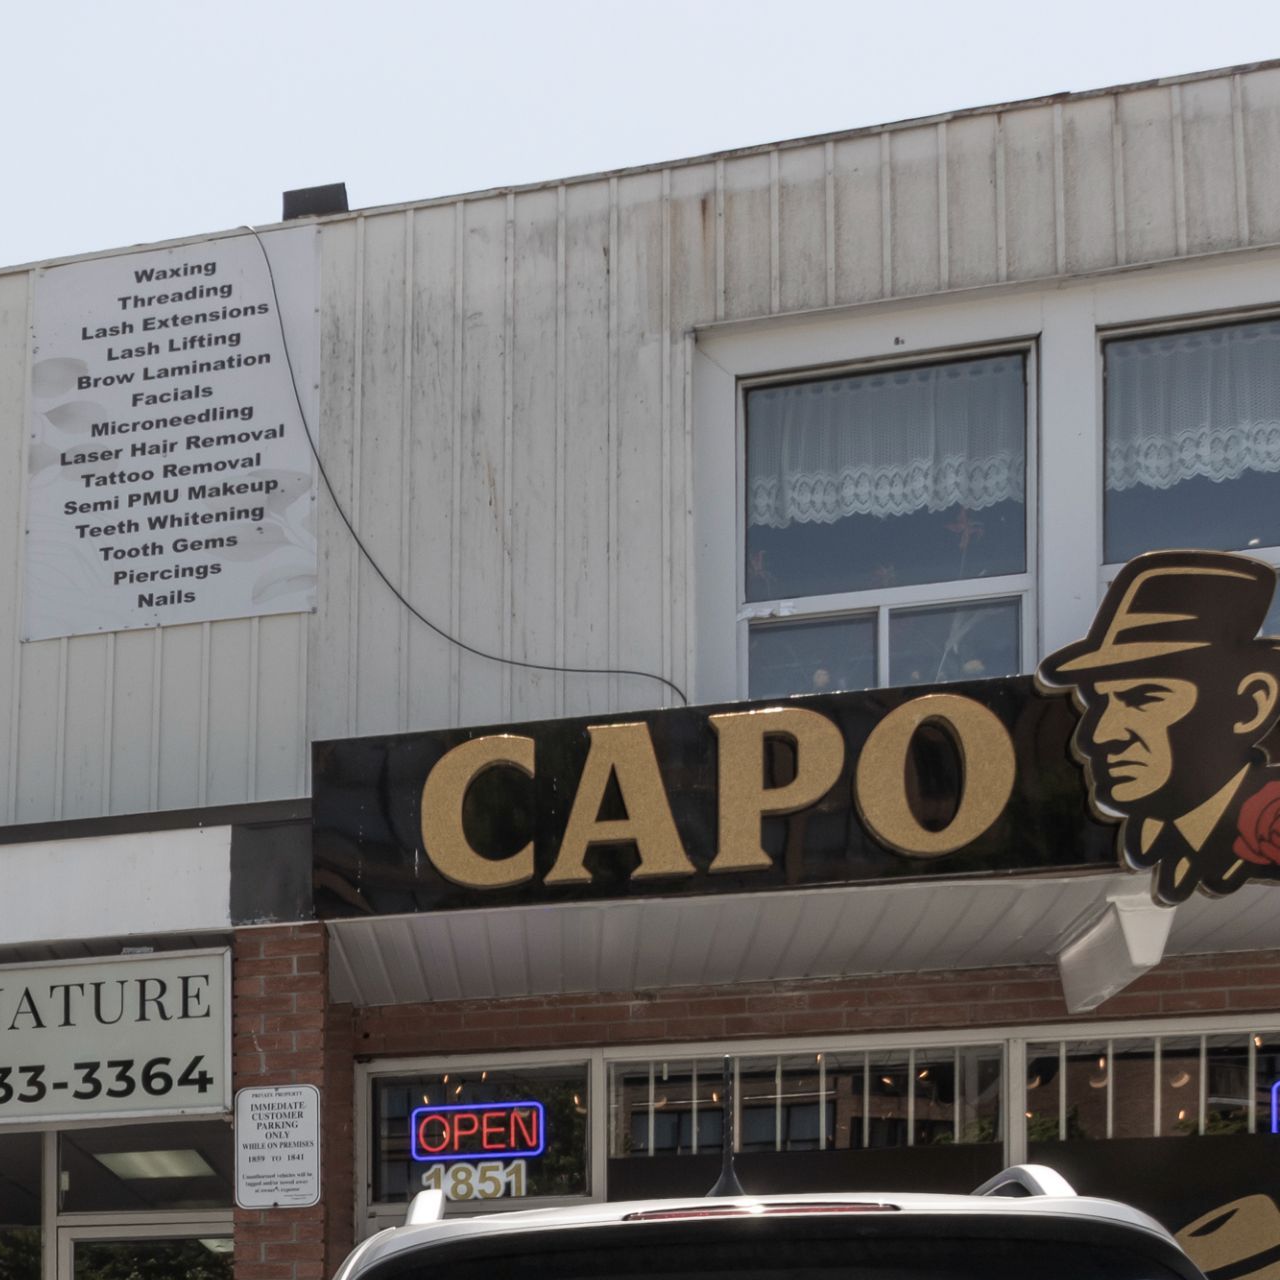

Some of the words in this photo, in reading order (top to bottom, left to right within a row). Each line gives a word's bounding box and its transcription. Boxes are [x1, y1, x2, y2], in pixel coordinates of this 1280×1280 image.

[134, 261, 217, 284] Waxing
[117, 283, 233, 310] Threading
[81, 322, 134, 341] Lash
[142, 302, 270, 332] Extensions
[106, 341, 160, 362] Lash
[168, 331, 242, 352] Lifting
[77, 371, 135, 390] Brow
[142, 352, 271, 381] Lamination
[131, 385, 214, 407] Facials
[90, 405, 254, 437] Microneedling
[60, 446, 123, 467] Laser
[130, 439, 179, 458] Hair
[185, 424, 285, 450] Removal
[81, 467, 155, 488] Tattoo
[162, 452, 261, 479] Removal
[63, 496, 119, 516] Semi
[127, 488, 179, 508] PMU
[187, 478, 279, 501] Makeup
[75, 519, 140, 539] Teeth
[147, 505, 265, 531] Whitening
[98, 541, 164, 562] Tooth
[172, 533, 238, 553] Gems
[113, 562, 222, 585] Piercings
[137, 589, 196, 608] Nails
[420, 692, 1018, 891] CAPO
[250, 1101, 305, 1111] IMMEDIATE
[251, 1110, 304, 1121] CUSTOMER
[256, 1121, 298, 1130] PARKING
[265, 1131, 290, 1139] ONLY
[418, 1109, 538, 1153] OPEN
[242, 1142, 266, 1150] WHILE
[279, 1140, 314, 1148] PREMISES
[422, 1159, 527, 1201] 1851
